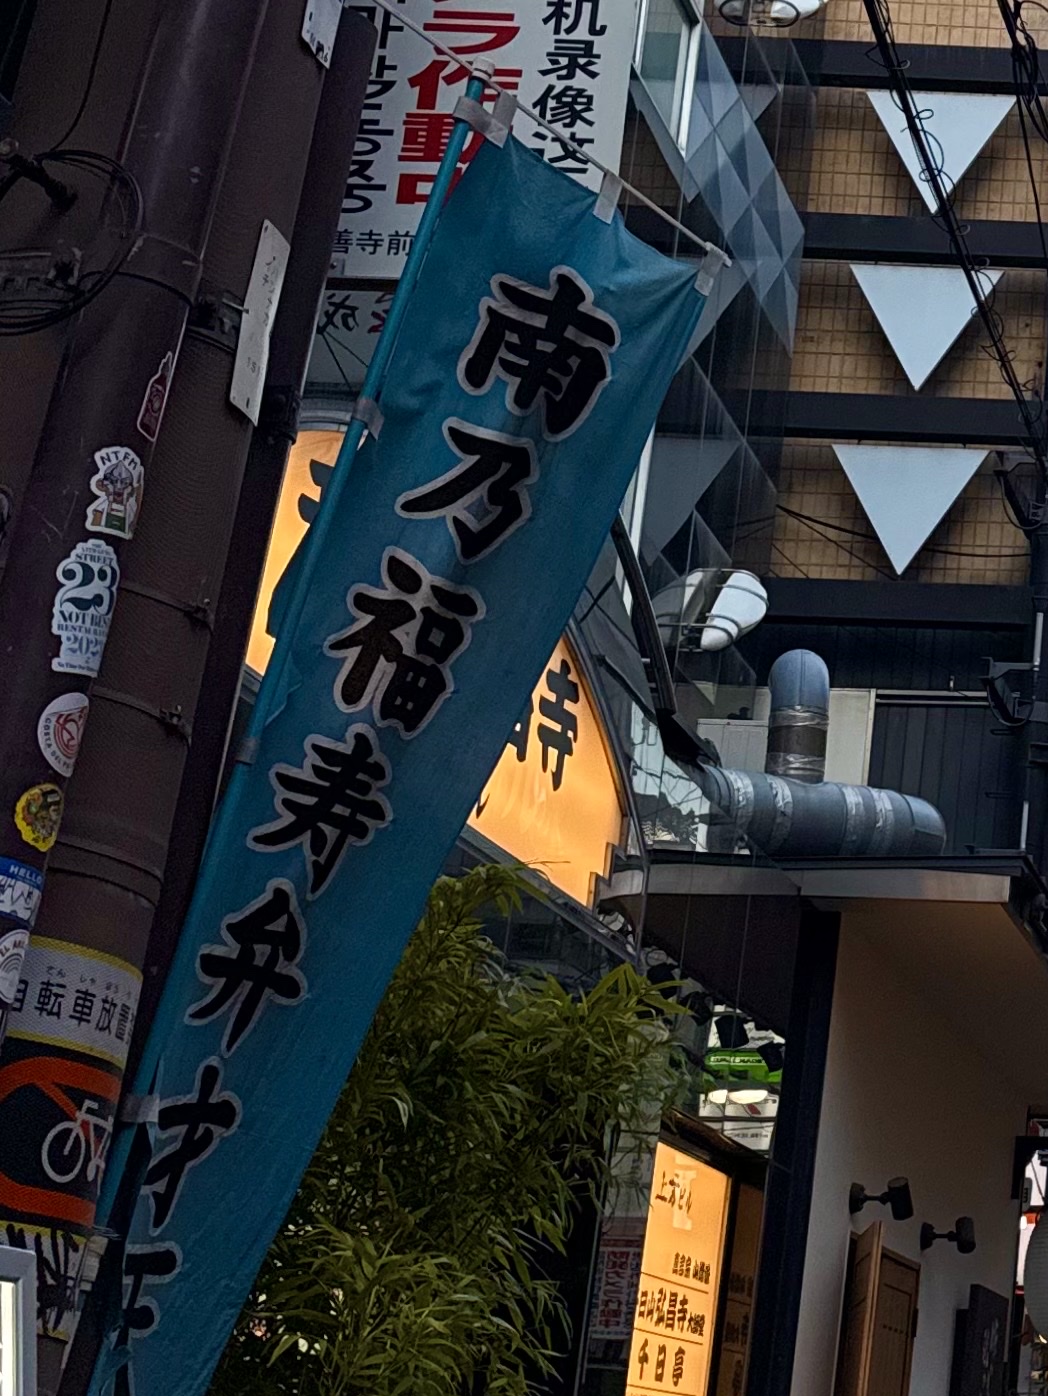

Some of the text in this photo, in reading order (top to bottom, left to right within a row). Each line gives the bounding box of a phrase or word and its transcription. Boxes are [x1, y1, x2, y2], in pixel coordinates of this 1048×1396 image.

[637, 1287, 689, 1333] 日山弘昌寺
